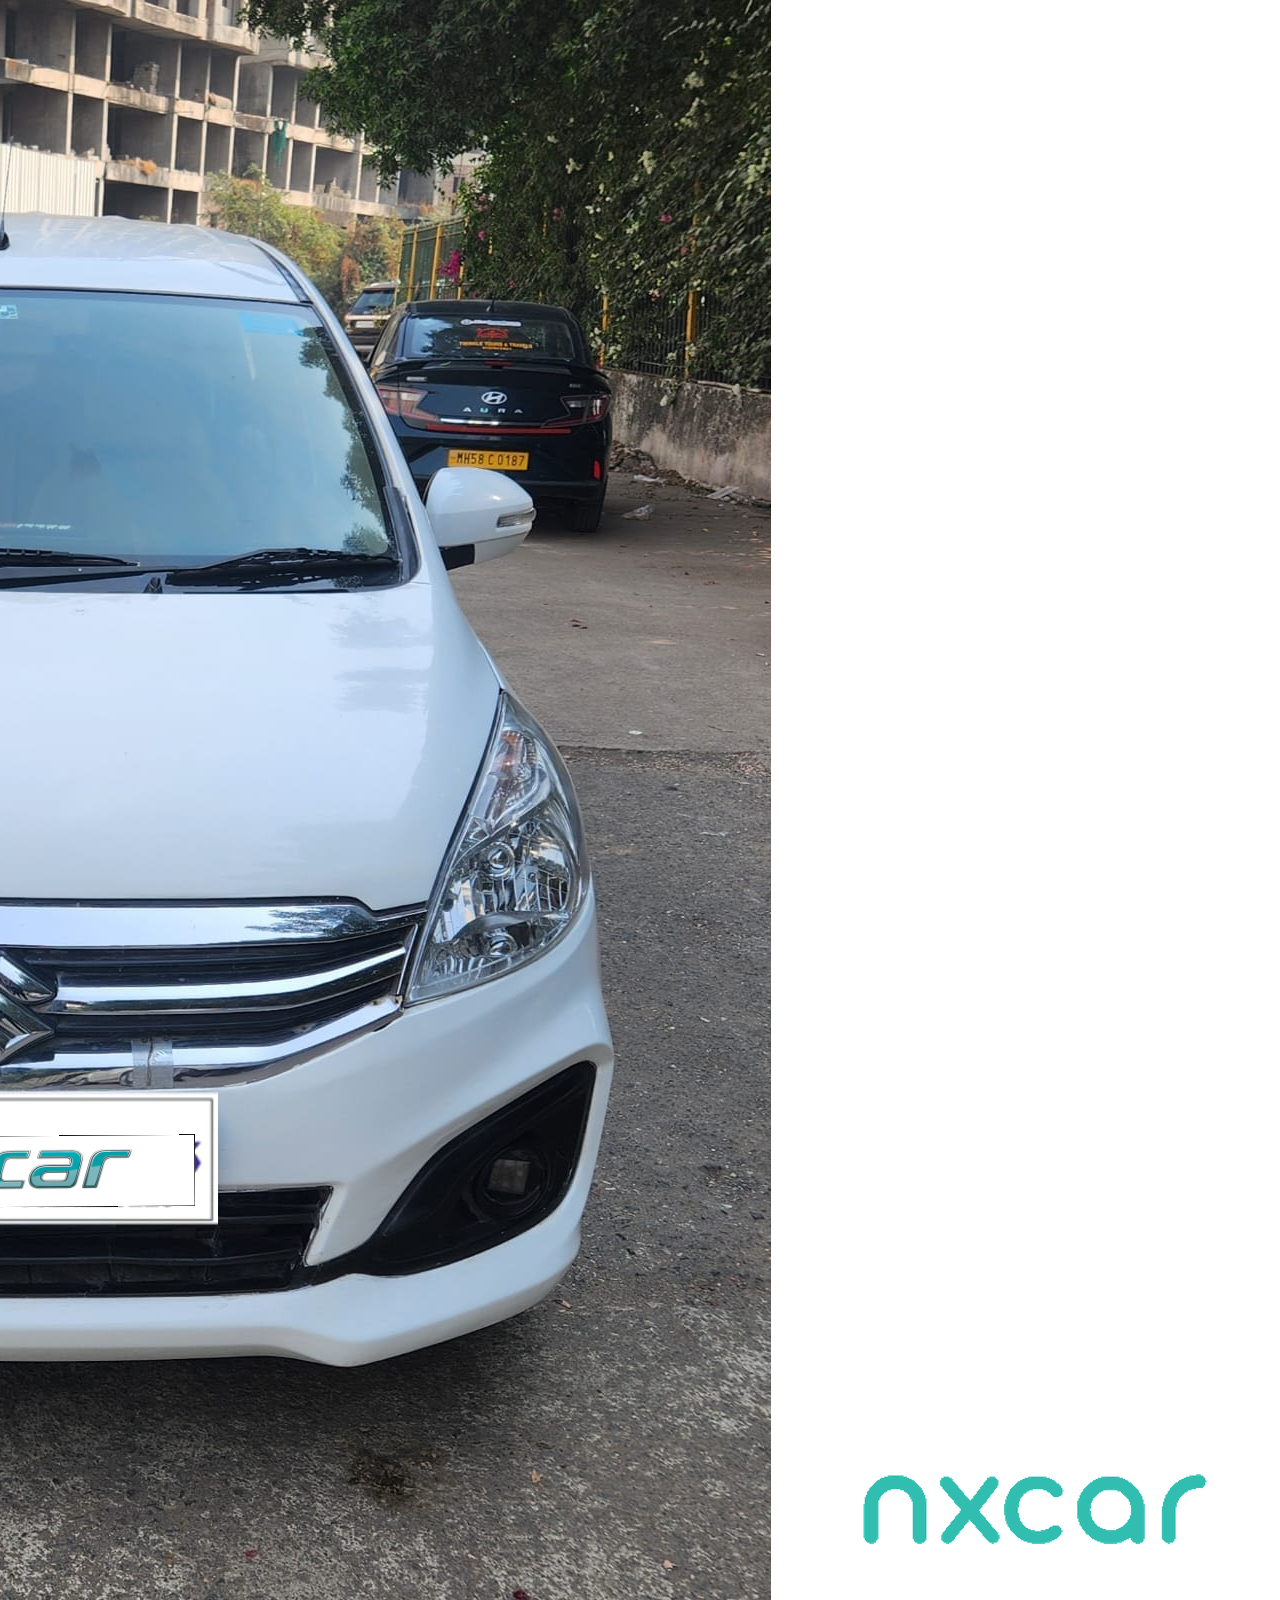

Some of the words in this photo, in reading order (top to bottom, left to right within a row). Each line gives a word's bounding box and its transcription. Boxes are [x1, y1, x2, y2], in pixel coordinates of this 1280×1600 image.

[462, 406, 524, 414] AURA
[456, 451, 485, 466] MH58
[487, 454, 495, 466] C
[497, 454, 526, 467] 0187
